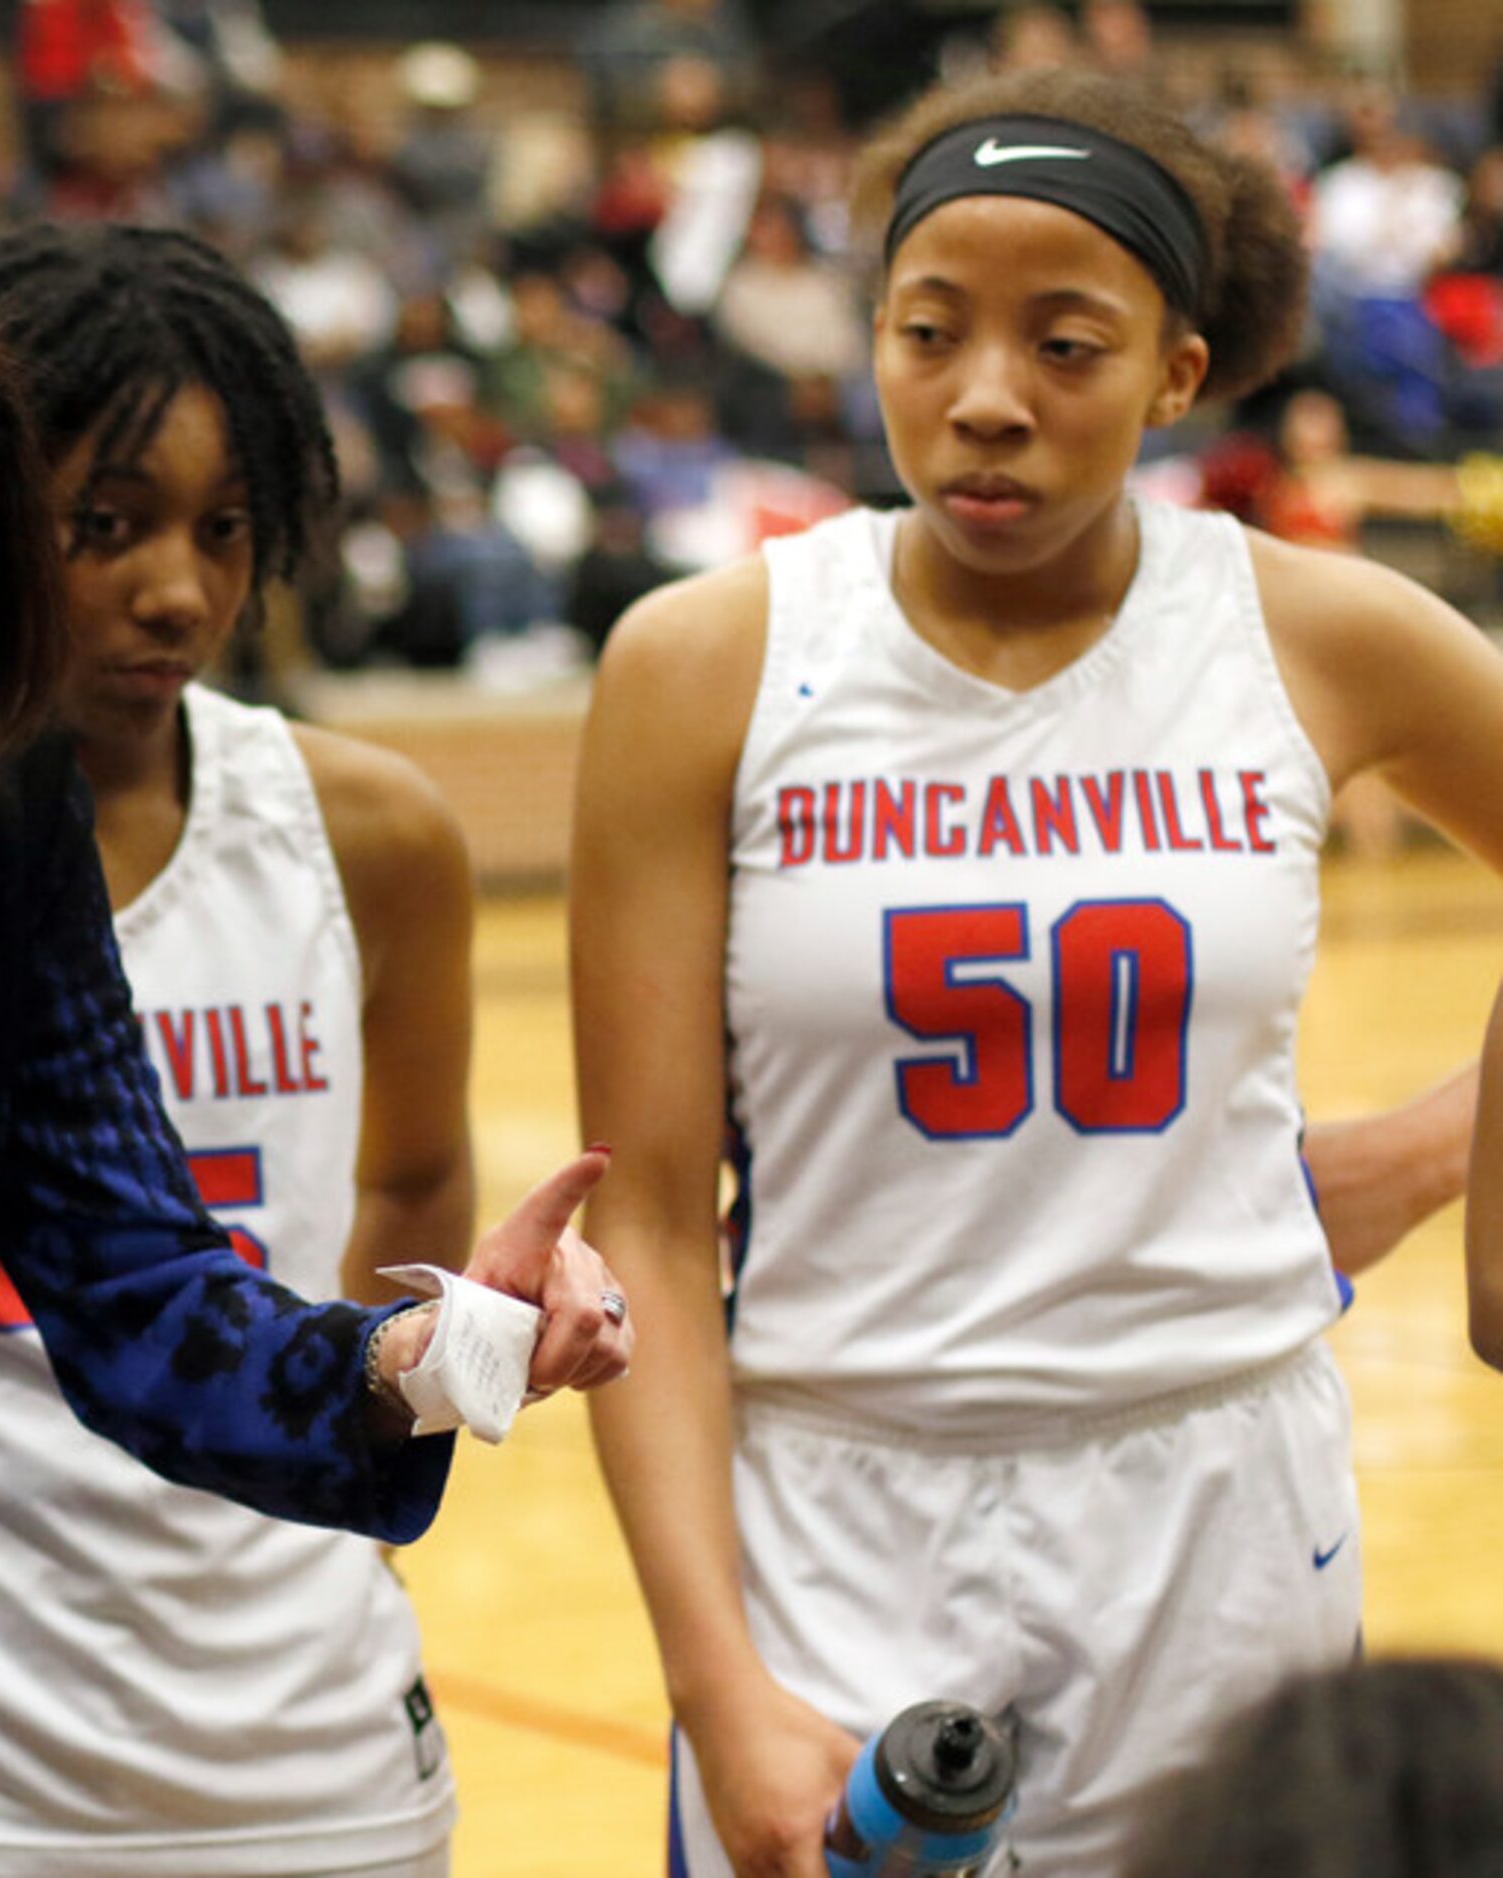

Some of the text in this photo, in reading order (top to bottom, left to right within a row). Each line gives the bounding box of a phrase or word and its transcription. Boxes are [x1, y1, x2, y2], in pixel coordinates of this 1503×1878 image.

[776, 767, 1277, 870] DUNCANVILLE
[135, 1000, 330, 1102] VILLE
[882, 896, 1194, 1142] 50
